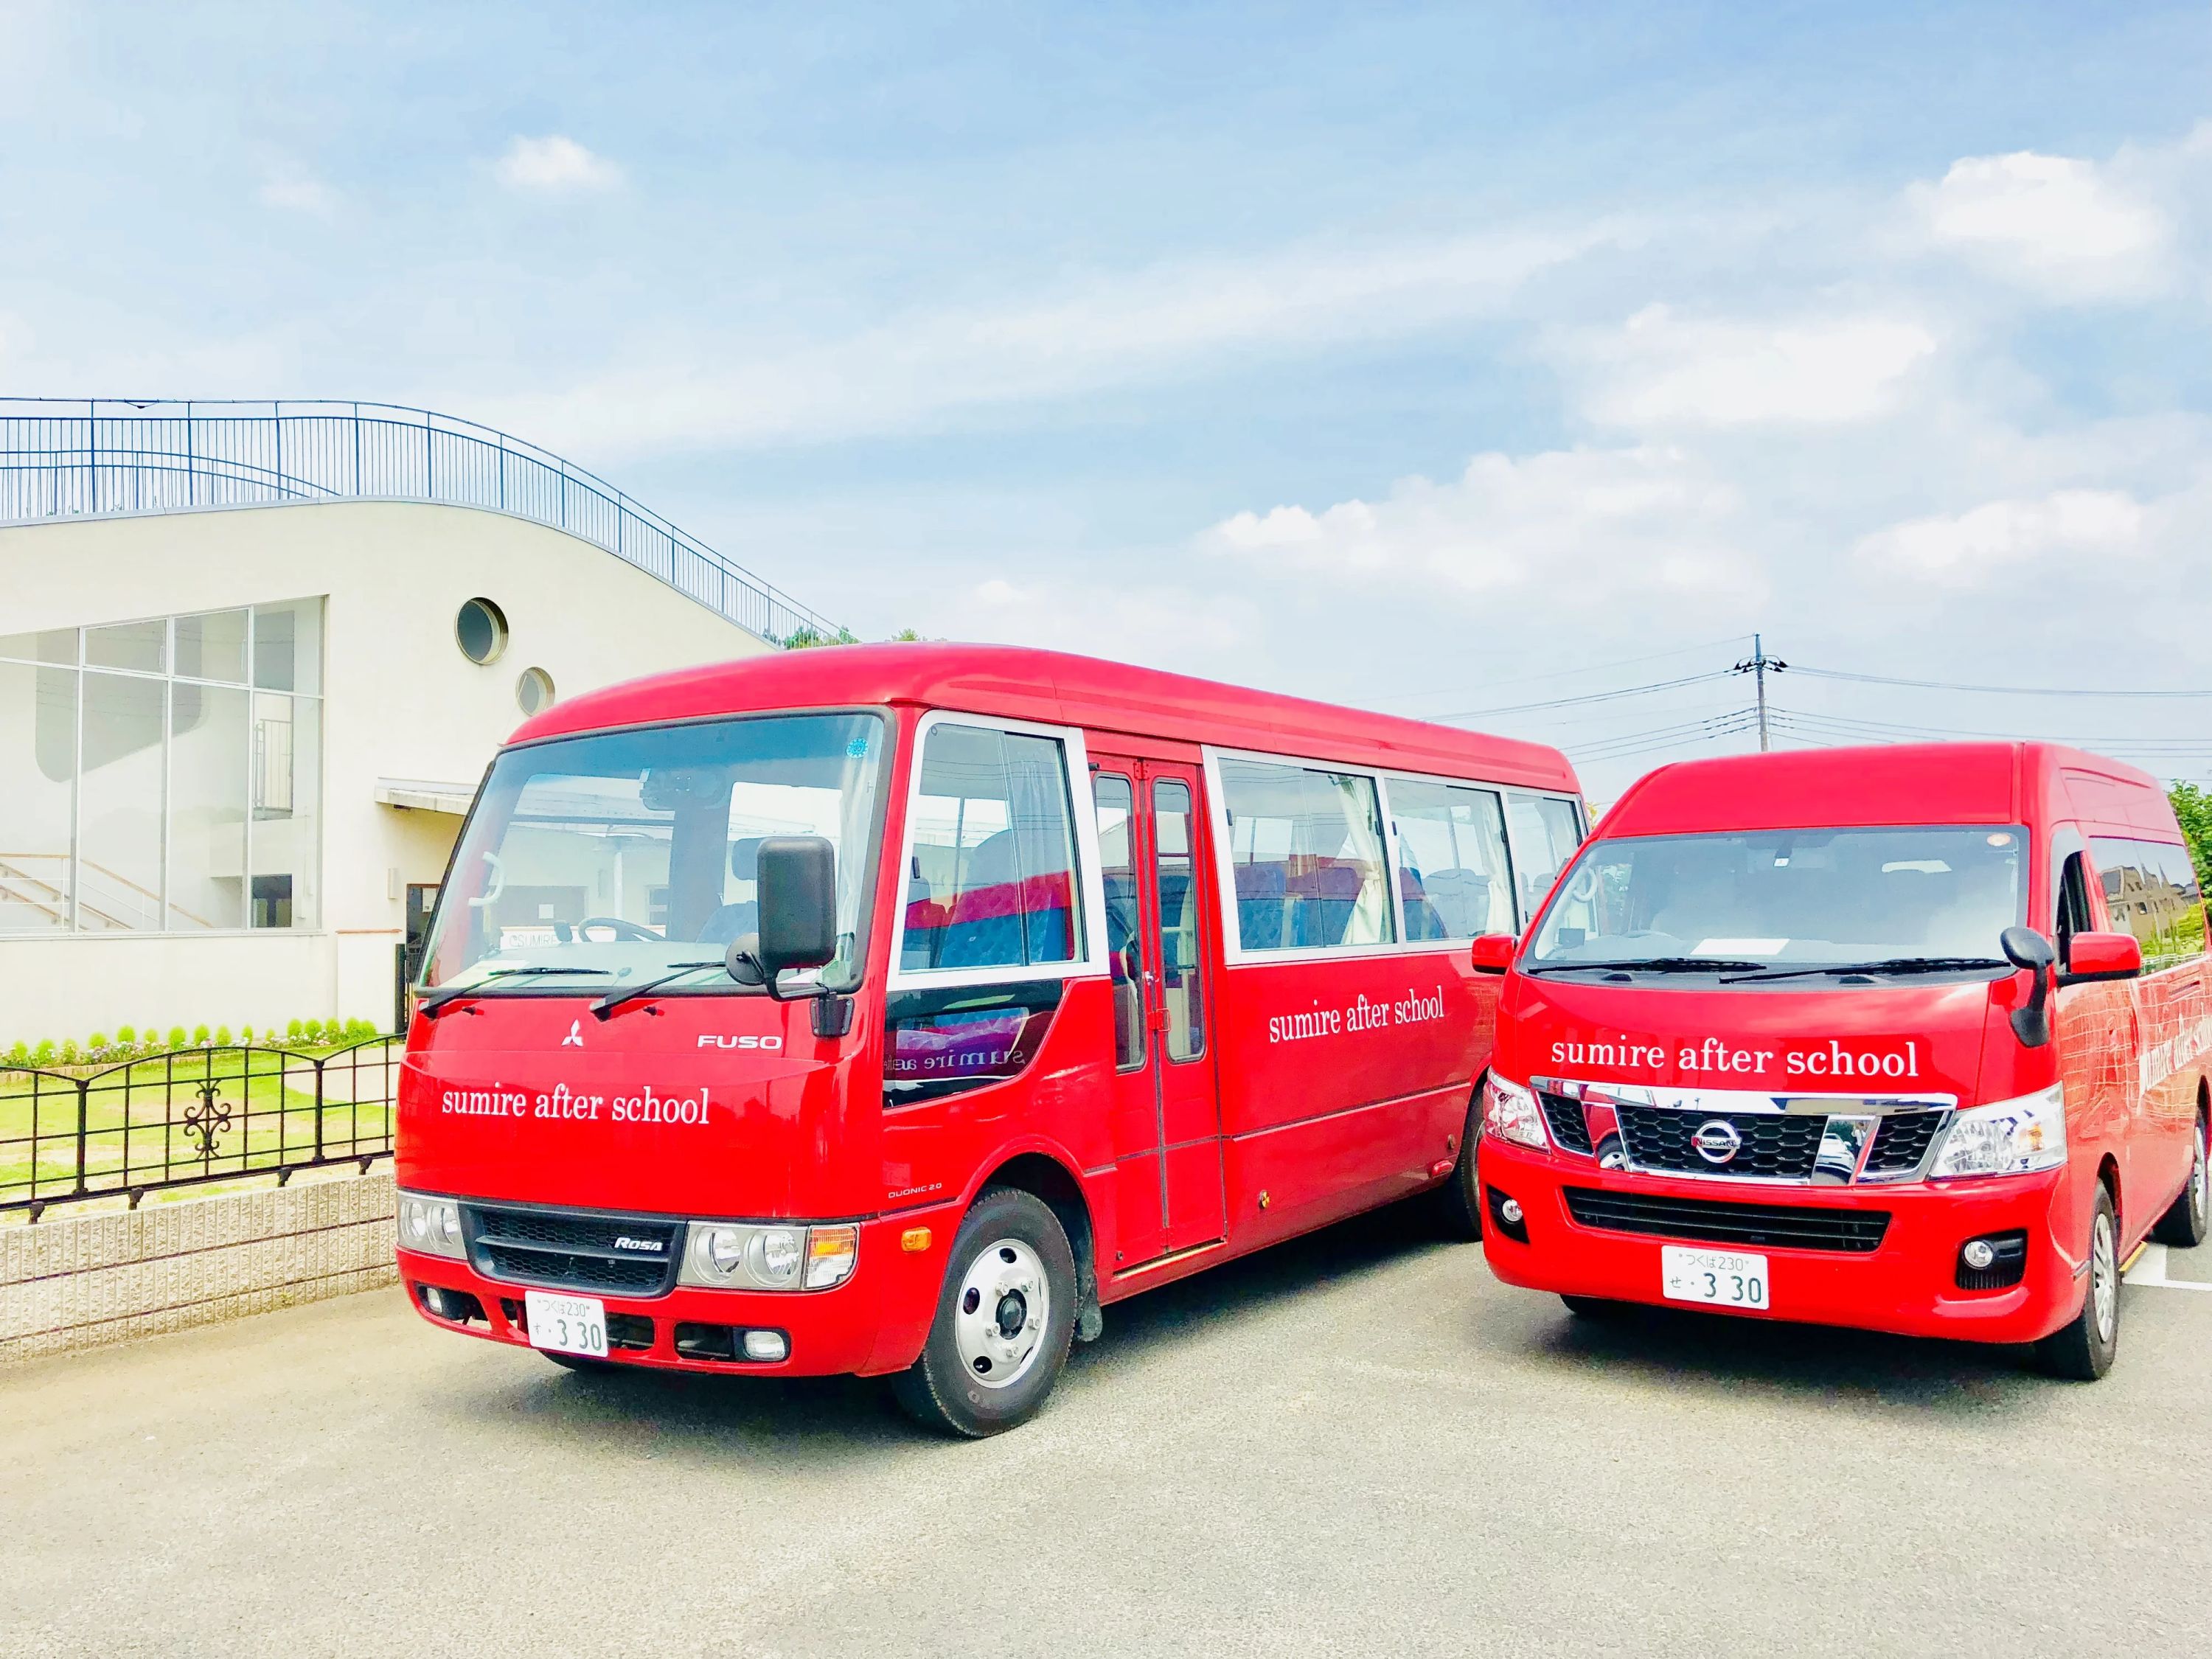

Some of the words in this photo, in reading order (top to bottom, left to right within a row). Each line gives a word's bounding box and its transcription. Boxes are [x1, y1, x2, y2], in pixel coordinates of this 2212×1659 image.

[1270, 999, 1340, 1043] sumire
[1346, 993, 1389, 1032] after
[1395, 985, 1444, 1024] school
[697, 1034, 782, 1049] FUSO
[1551, 1034, 1665, 1068] sumire
[1679, 1037, 1774, 1074] after
[1787, 1040, 1919, 1077] school
[442, 1081, 527, 1117] sumire
[535, 1083, 603, 1119] after
[612, 1086, 710, 1124] school
[1697, 1138, 1736, 1147] NISSAN
[888, 1186, 927, 1198] DUONIC
